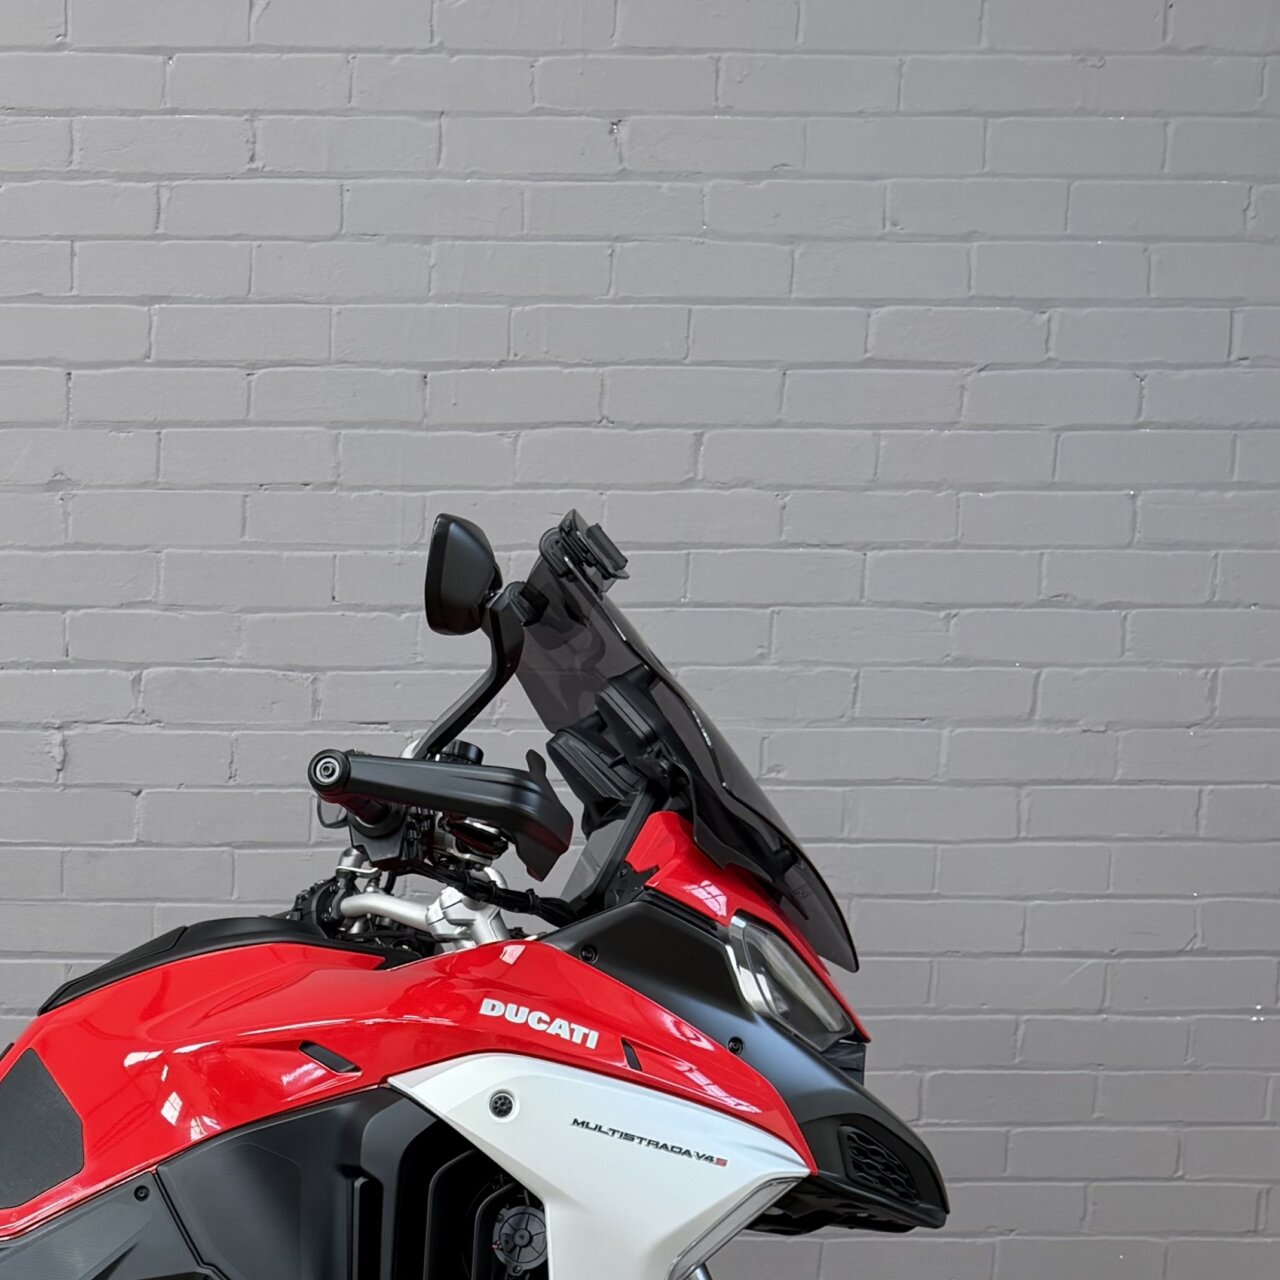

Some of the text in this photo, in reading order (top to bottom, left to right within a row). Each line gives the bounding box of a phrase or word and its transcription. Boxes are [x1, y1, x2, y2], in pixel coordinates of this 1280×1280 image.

[479, 998, 599, 1050] DUCATI
[571, 1117, 728, 1168] MULTISTRADA V4S
